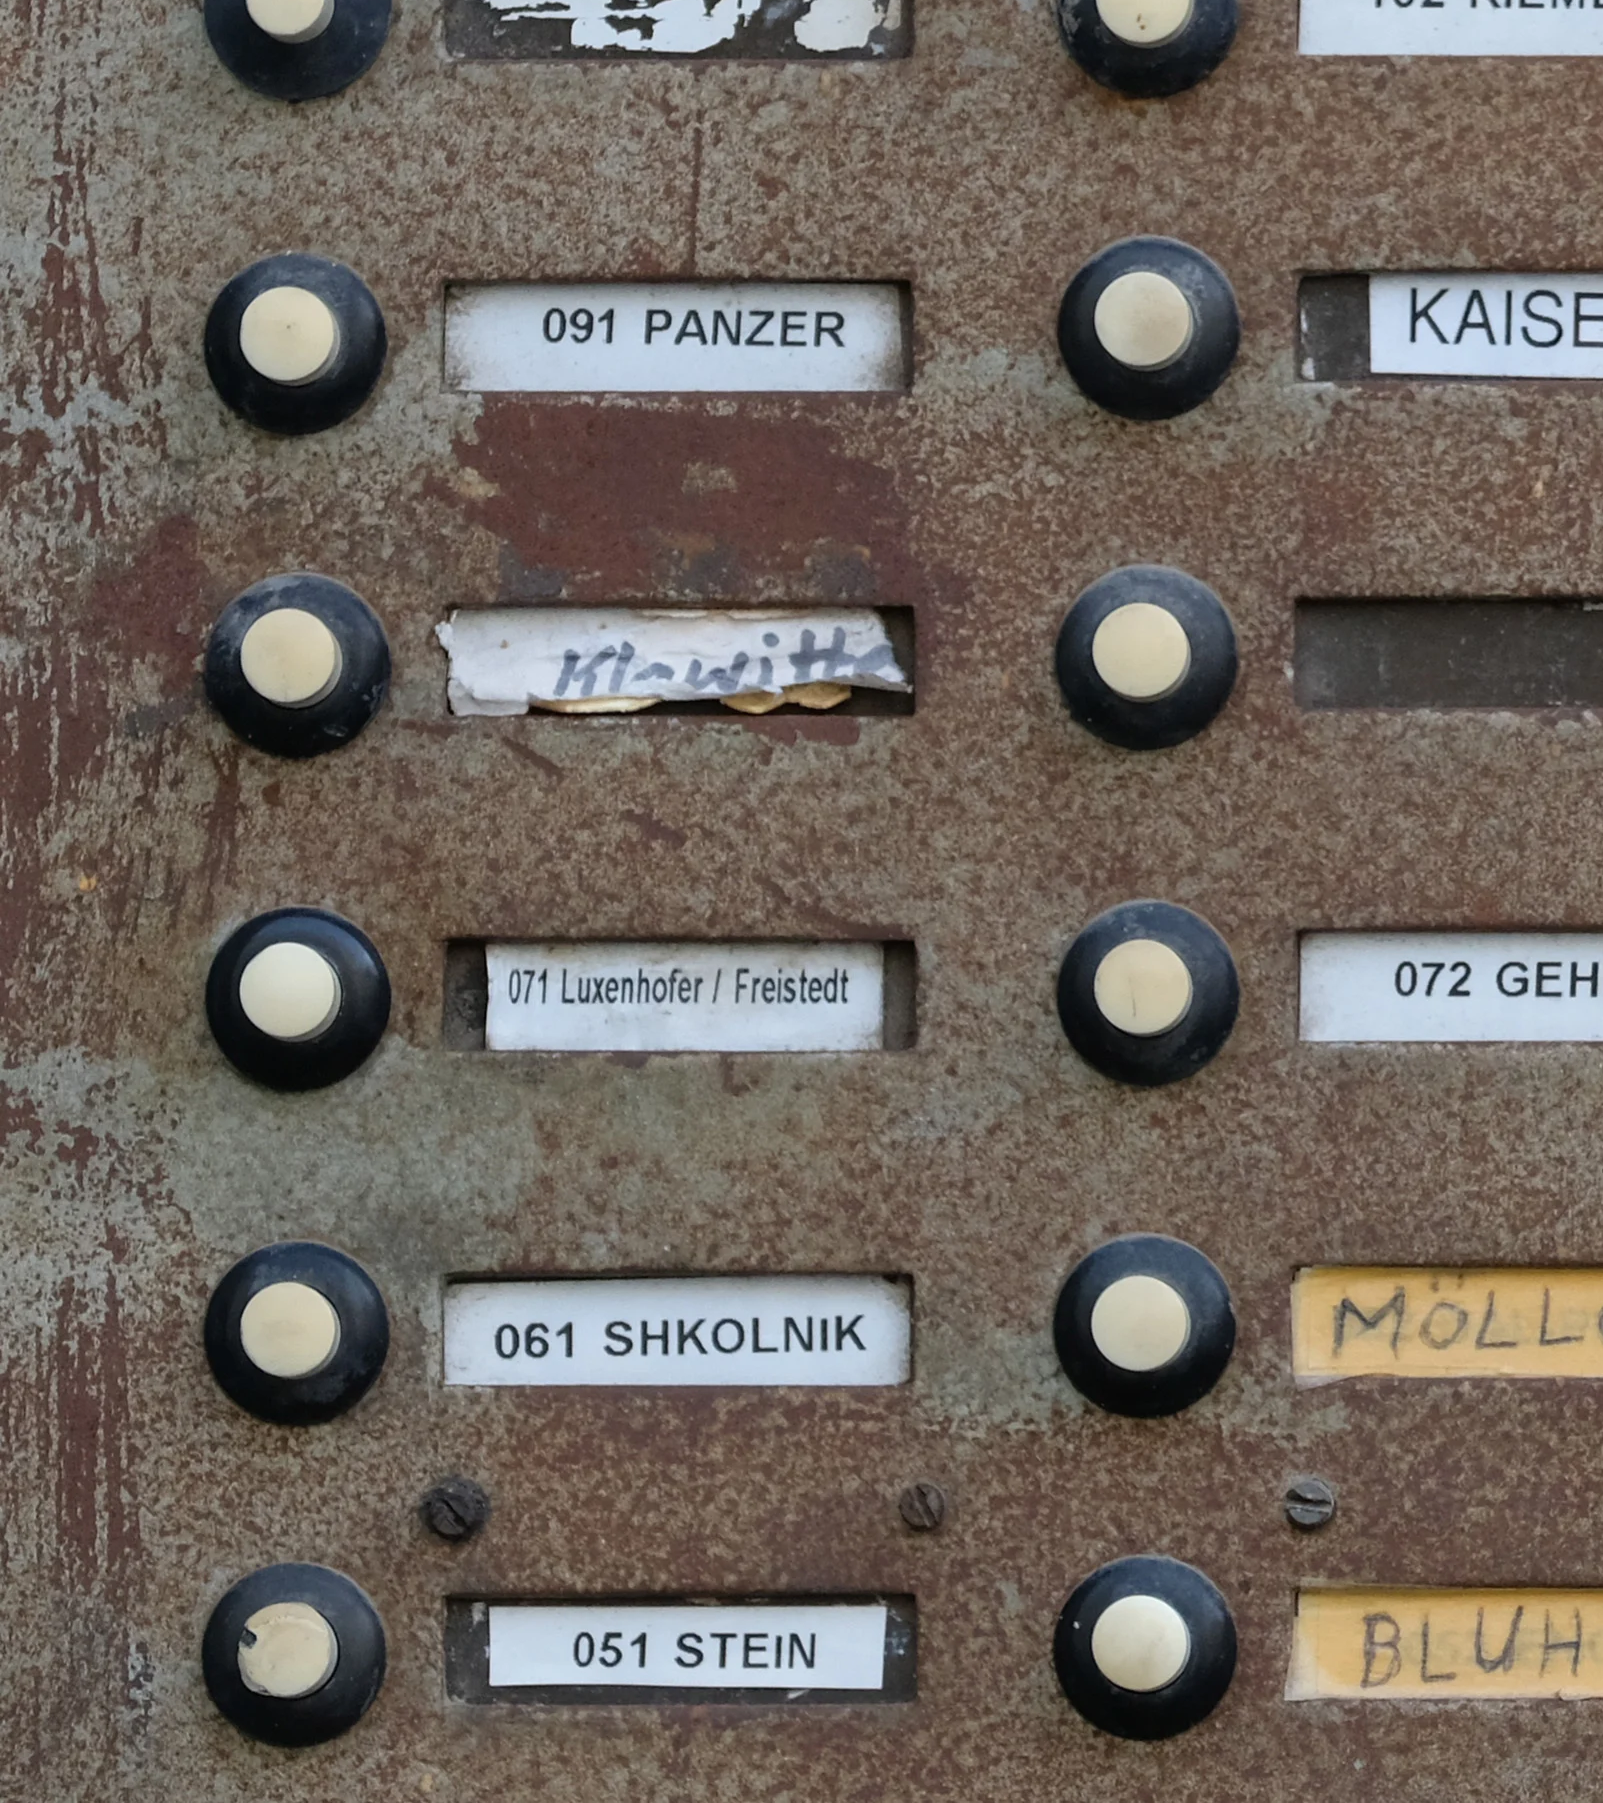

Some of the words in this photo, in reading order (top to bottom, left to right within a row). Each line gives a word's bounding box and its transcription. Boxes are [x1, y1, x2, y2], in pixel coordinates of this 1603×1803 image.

[542, 307, 615, 344] 091
[644, 308, 845, 348] PANZER
[508, 967, 548, 1005] 071
[561, 967, 704, 1004] Luxenhofer
[711, 967, 723, 1004] /
[735, 967, 849, 1004] Freistedt
[1394, 960, 1472, 997] 072
[494, 1321, 573, 1360] 061
[603, 1314, 867, 1357] SHKOLNIK
[573, 1631, 647, 1668] 051
[674, 1632, 816, 1669] STEIN
